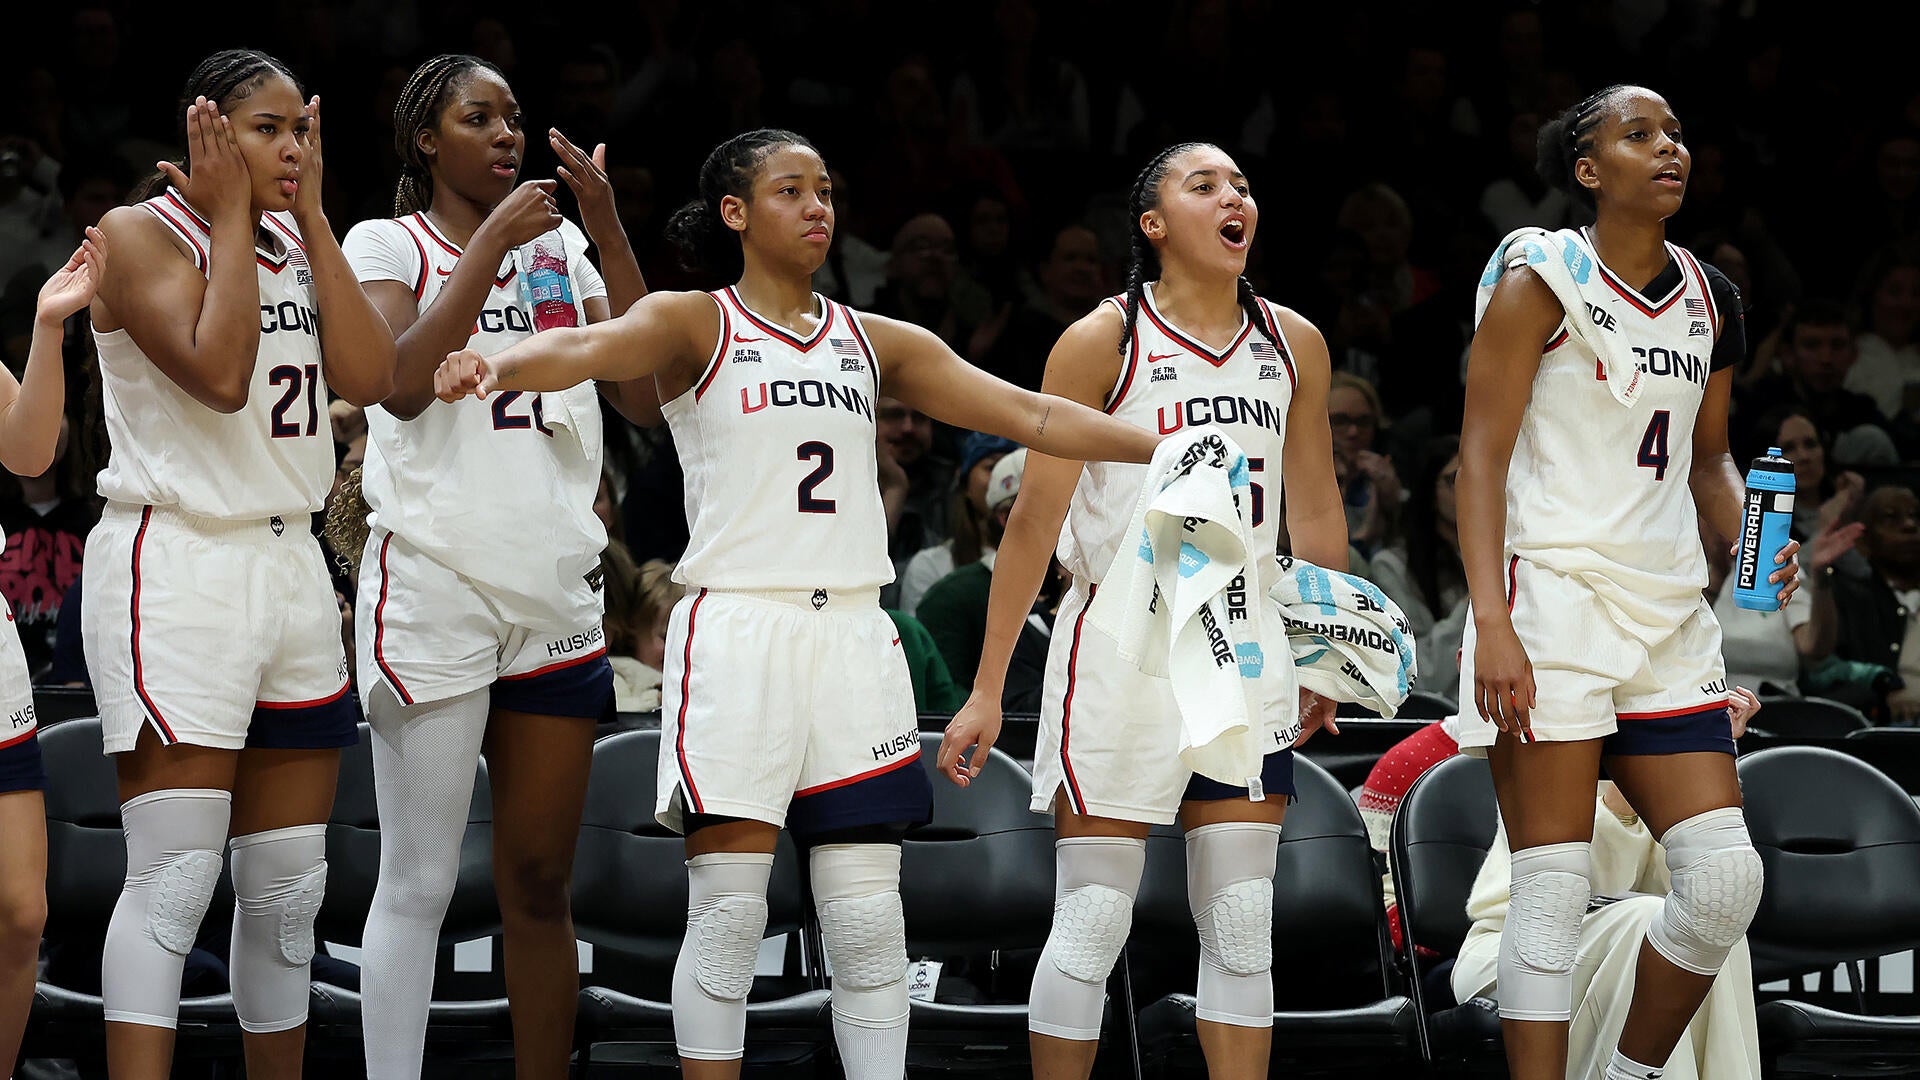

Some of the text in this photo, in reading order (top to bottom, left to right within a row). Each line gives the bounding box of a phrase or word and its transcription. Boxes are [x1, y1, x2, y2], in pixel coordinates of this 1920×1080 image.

[260, 301, 317, 337] CONN
[1688, 327, 1710, 335] EAST
[732, 356, 762, 364] CHANGE
[735, 349, 760, 357] BE THE
[1150, 373, 1178, 383] CHANGE
[1152, 366, 1176, 375] BE THE
[269, 364, 318, 438] 21
[740, 380, 873, 424] UCONN
[1157, 396, 1281, 437] UCONN
[1637, 409, 1671, 481] 4
[796, 440, 837, 514] 2
[1700, 678, 1727, 696] HU
[10, 704, 35, 728] HUS
